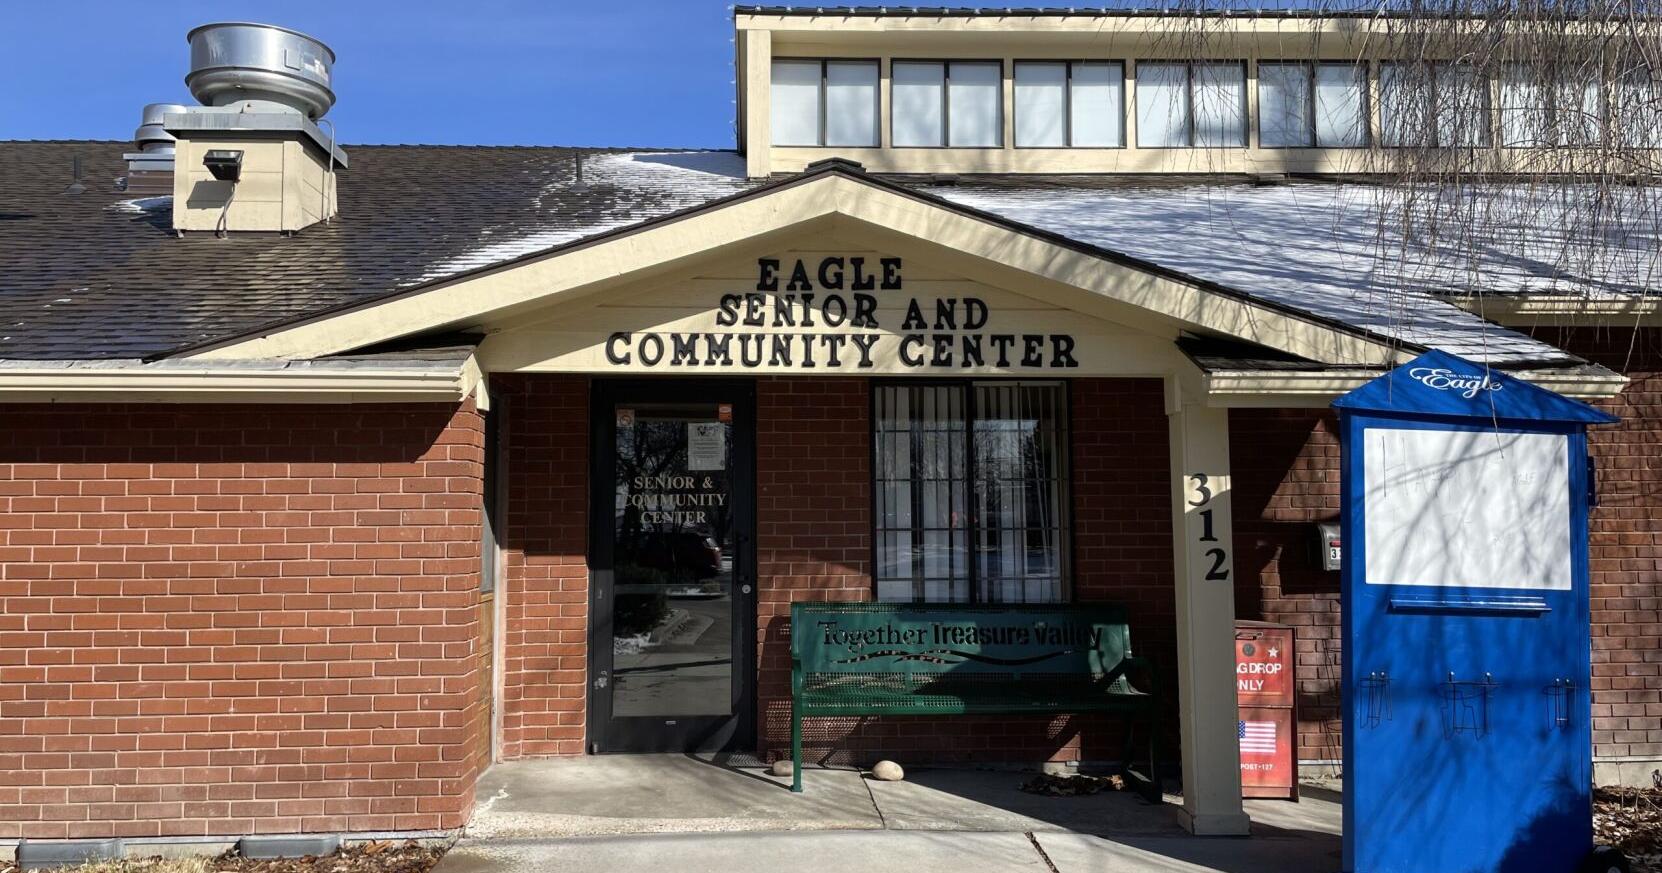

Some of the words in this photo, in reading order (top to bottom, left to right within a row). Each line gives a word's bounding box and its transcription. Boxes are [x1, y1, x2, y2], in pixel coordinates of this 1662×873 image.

[756, 256, 903, 291] EAGLE
[716, 293, 880, 328] SENIOR
[901, 297, 989, 331] AND
[605, 331, 881, 368] COMMUNITY
[899, 333, 1079, 368] CENTER
[1409, 367, 1503, 399] Eagle
[634, 476, 695, 489] SENIOR
[702, 476, 713, 489] &
[624, 493, 727, 506] COMMUNITY
[640, 511, 706, 524] CENTER
[817, 620, 928, 653] Together
[931, 620, 1029, 647] Treasure
[1249, 662, 1282, 674] DROP
[1237, 679, 1264, 691] NLY
